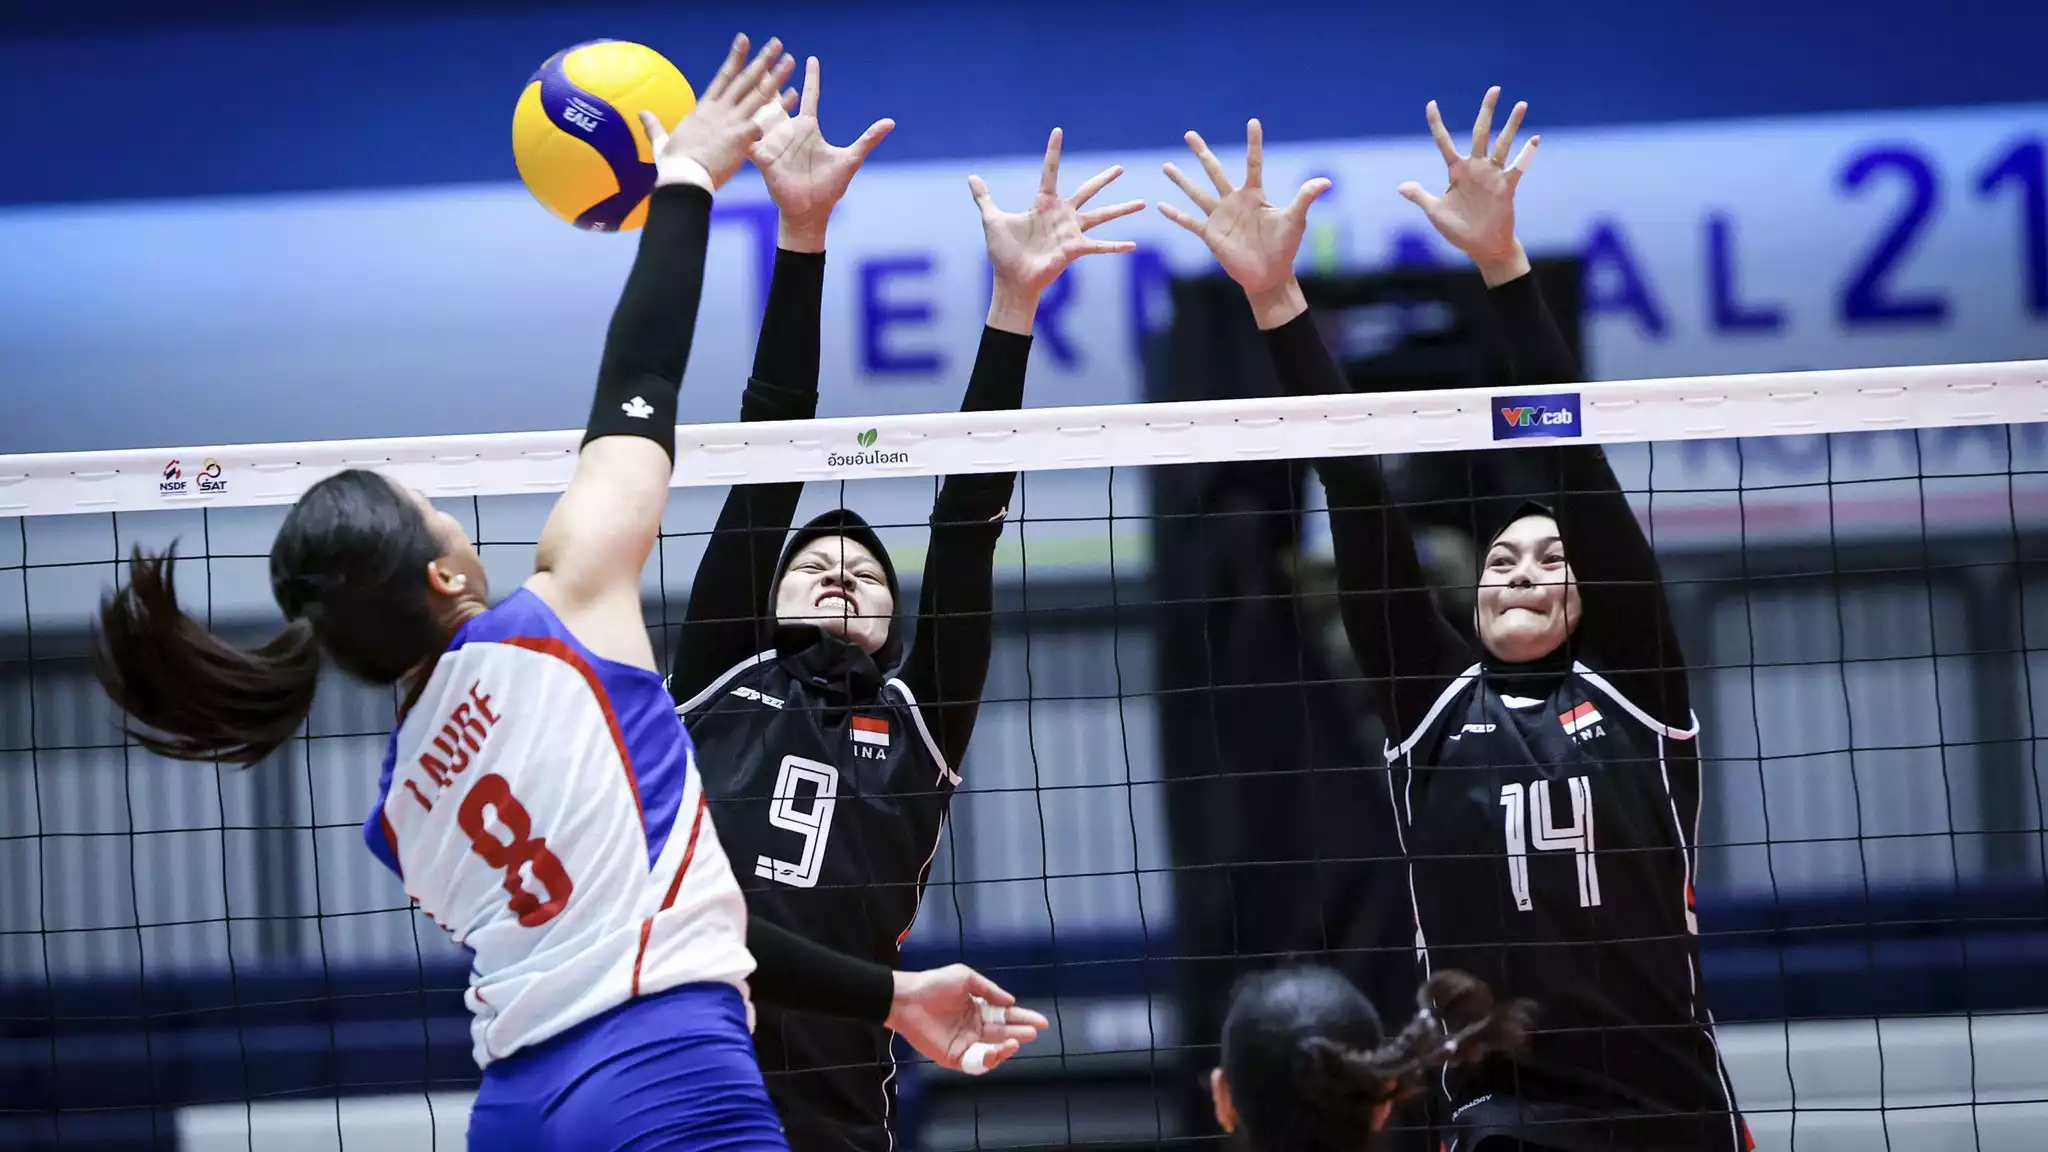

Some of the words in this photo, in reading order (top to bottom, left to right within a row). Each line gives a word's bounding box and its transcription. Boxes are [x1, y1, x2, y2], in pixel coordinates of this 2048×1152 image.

[1836, 138, 2048, 332] 21
[1501, 405, 1573, 427] VTVcab
[160, 481, 187, 491] NSDF
[199, 480, 228, 491] SAT
[853, 745, 887, 760] INA
[458, 773, 574, 928] 8
[754, 754, 839, 888] 9
[1500, 775, 1601, 911] 14
